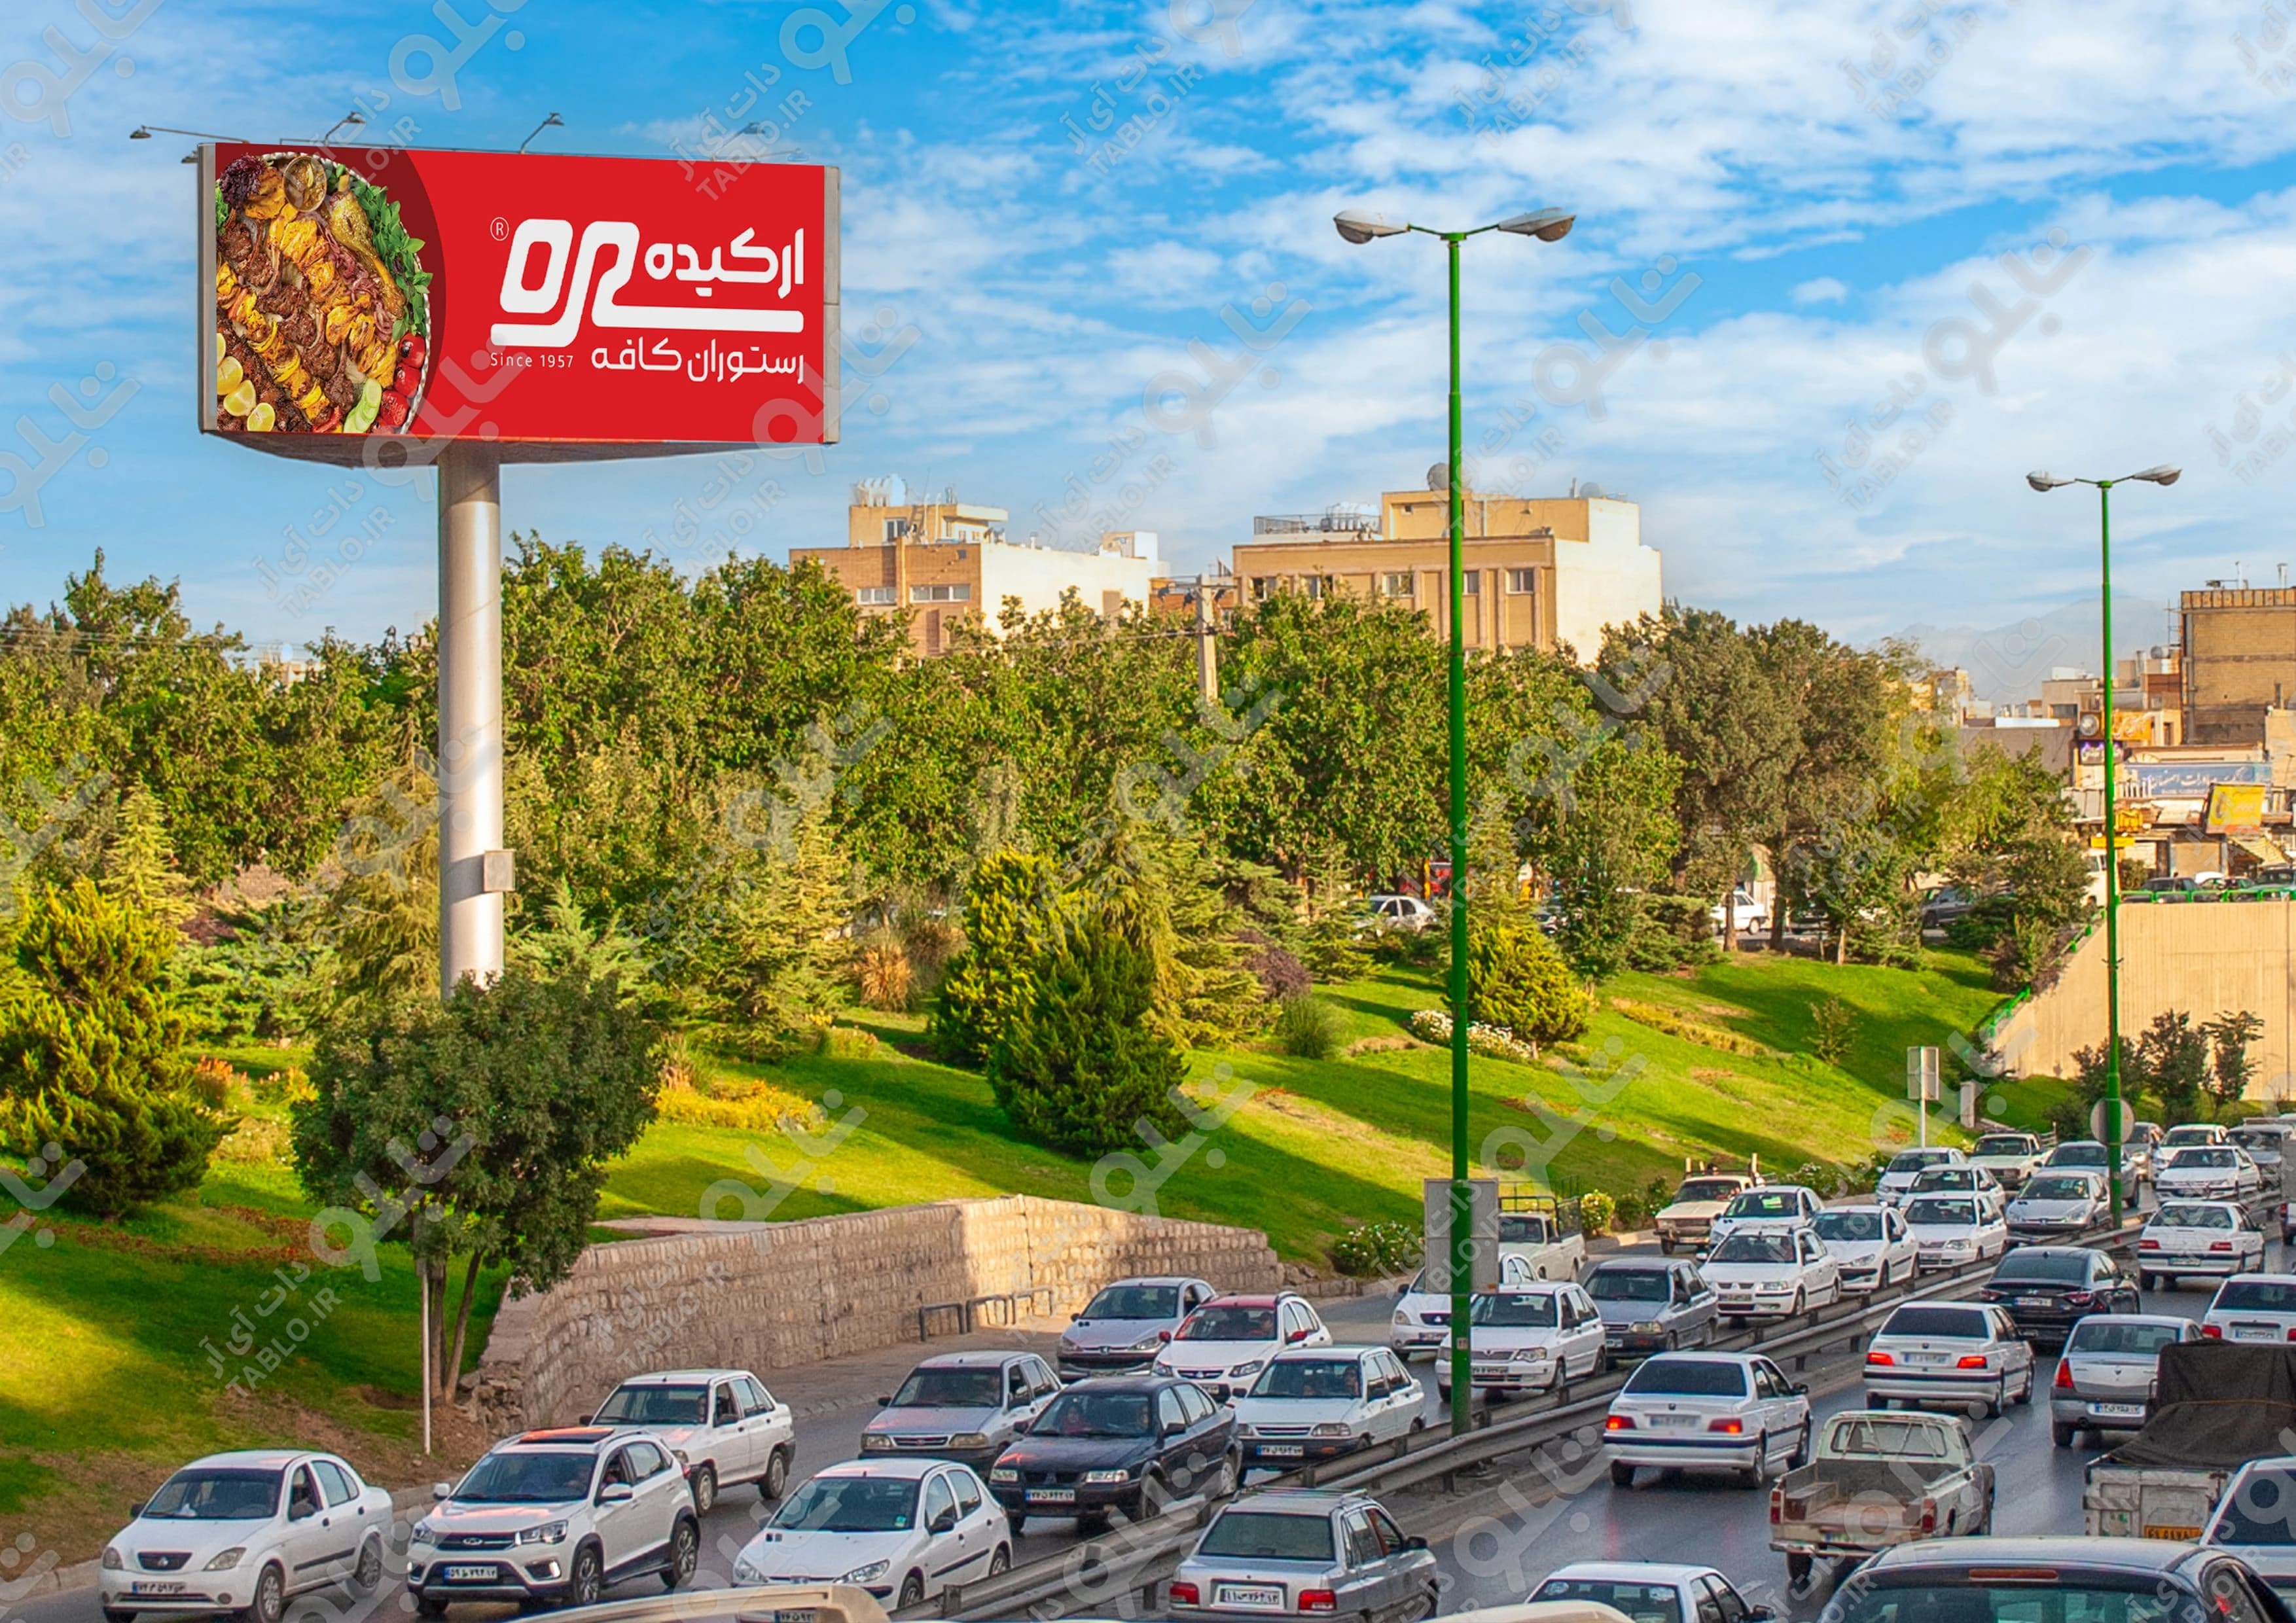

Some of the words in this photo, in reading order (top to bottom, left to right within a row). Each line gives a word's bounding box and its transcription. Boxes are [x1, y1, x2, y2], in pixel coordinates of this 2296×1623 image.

[644, 227, 804, 299] ارکیده
[490, 352, 533, 367] Since
[540, 354, 573, 368] 1957
[591, 336, 682, 371] کافه
[687, 338, 804, 384] رستوران
